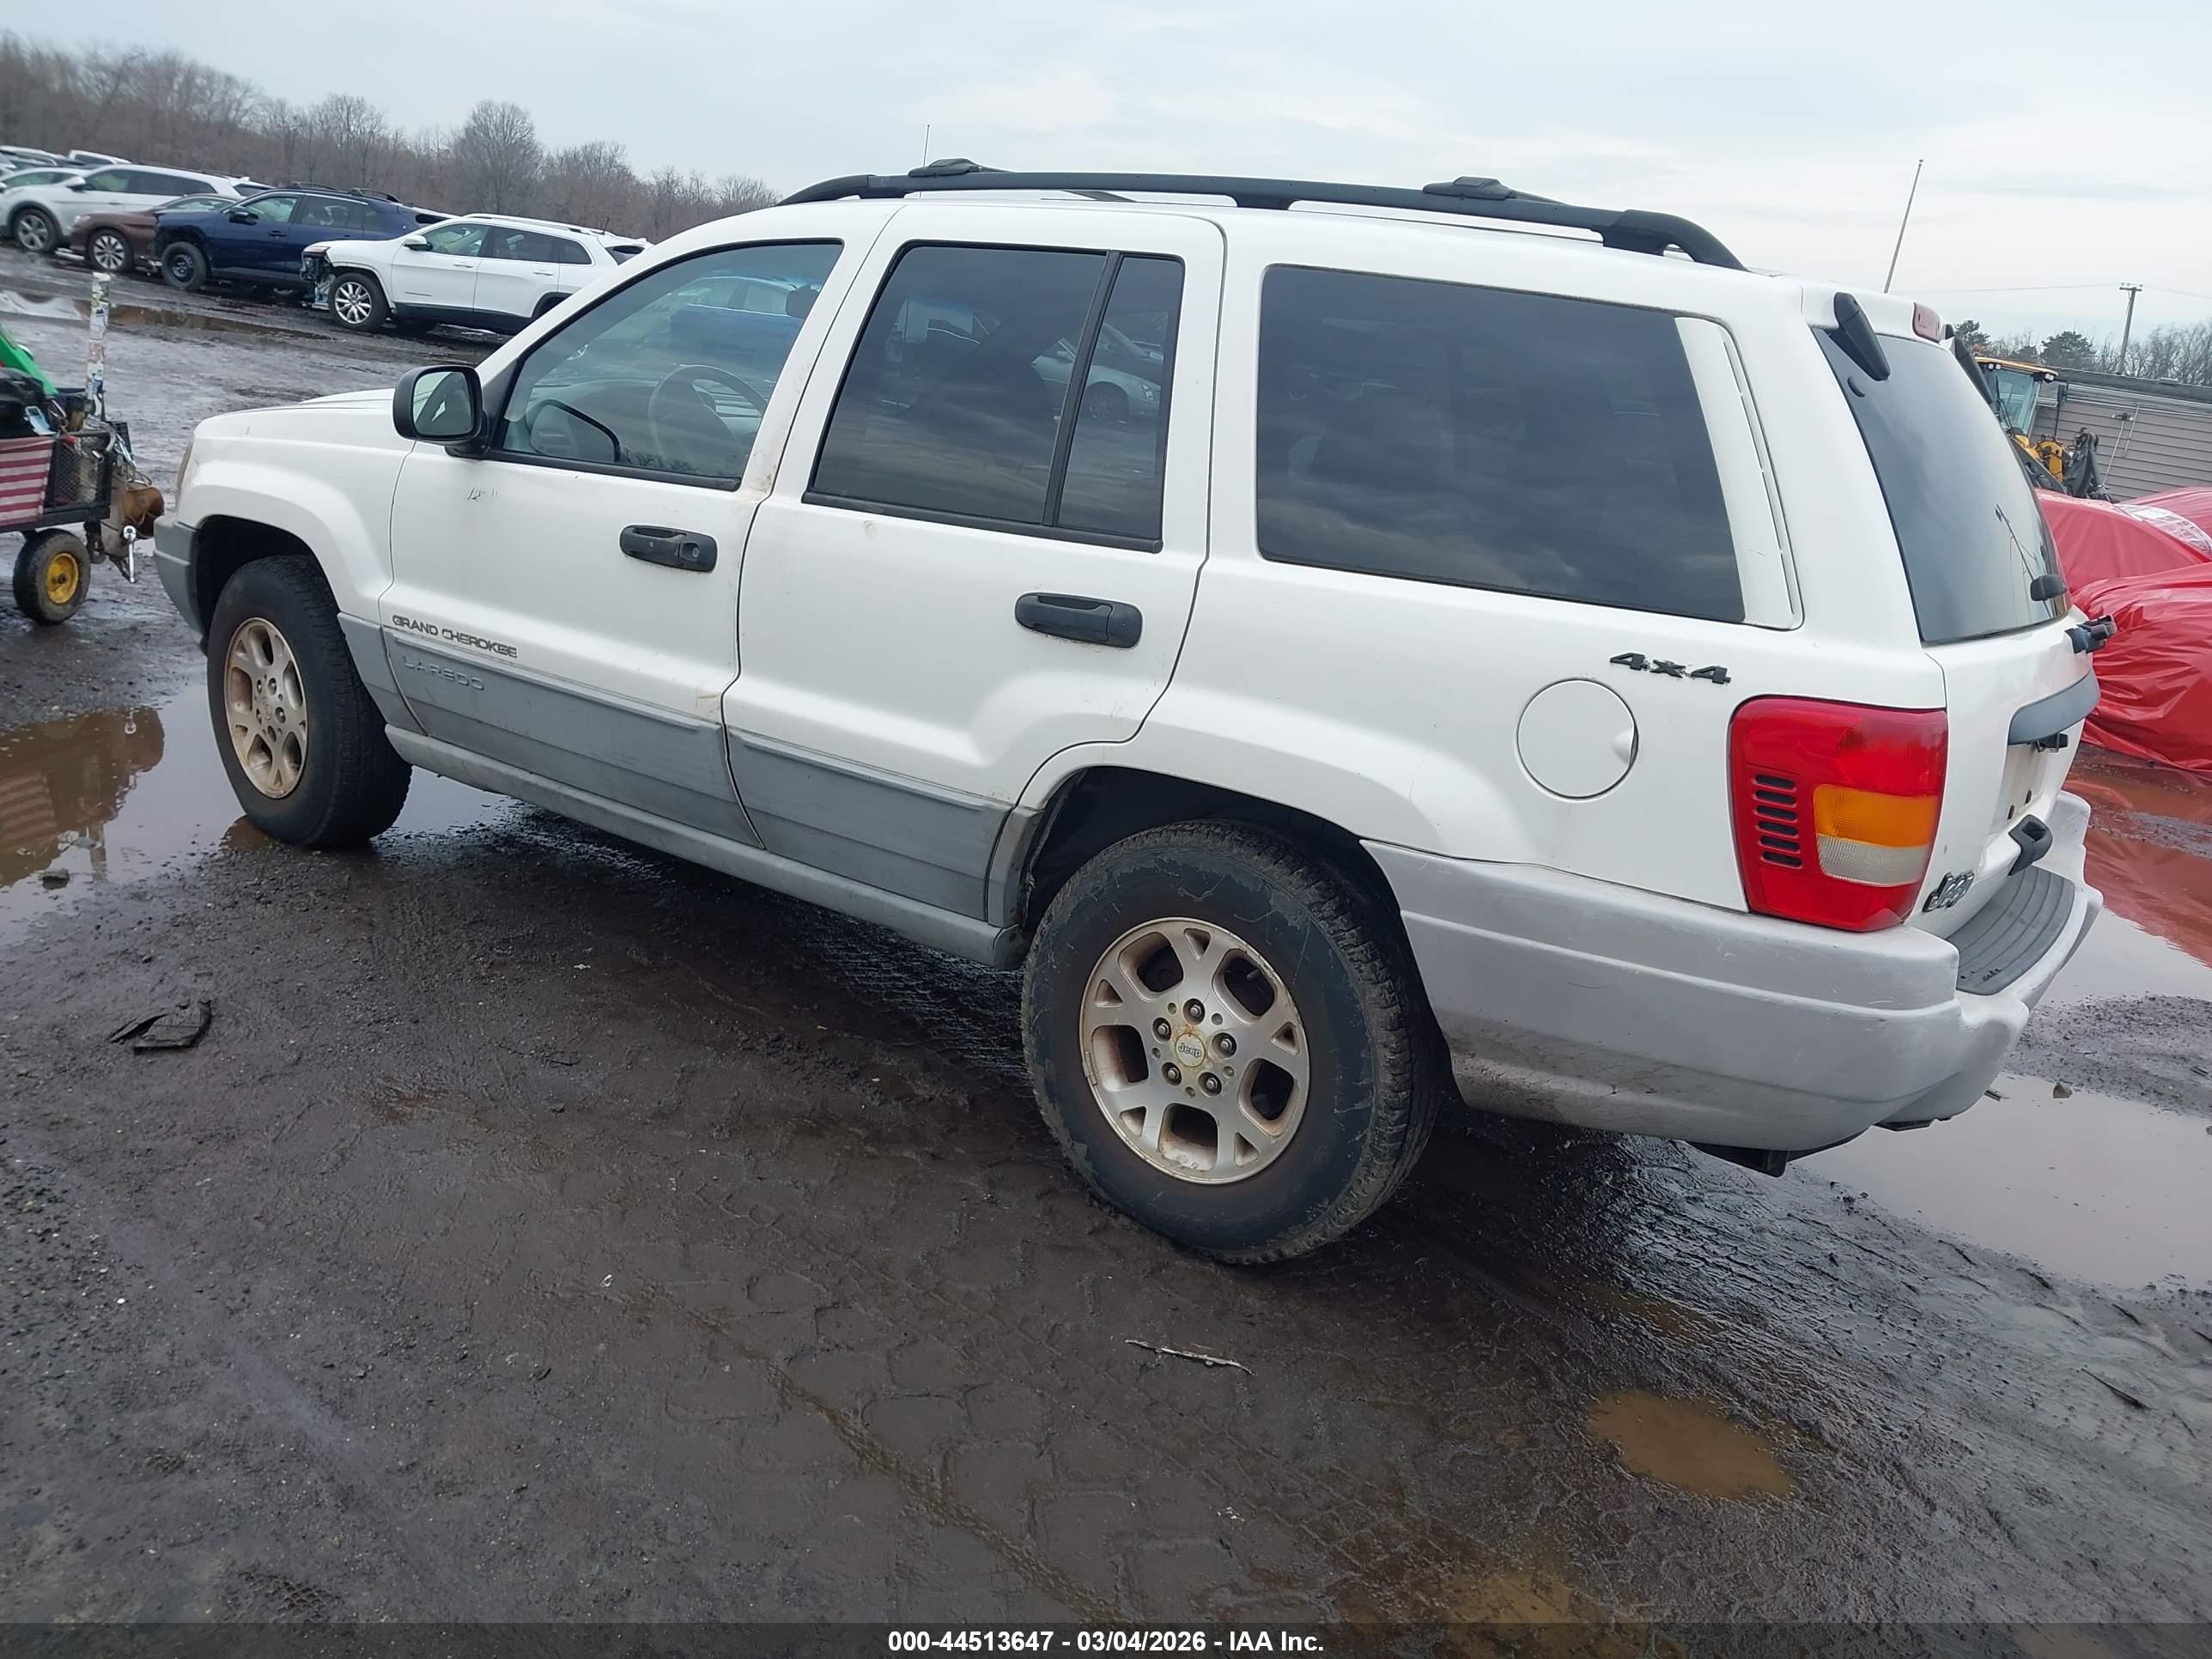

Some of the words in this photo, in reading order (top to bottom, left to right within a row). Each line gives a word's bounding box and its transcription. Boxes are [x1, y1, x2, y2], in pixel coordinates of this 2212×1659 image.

[392, 615, 438, 635] GRAND
[441, 628, 518, 659] CHEROKEE
[404, 656, 484, 690] LAREDO
[1178, 1042, 1201, 1058] Jeep
